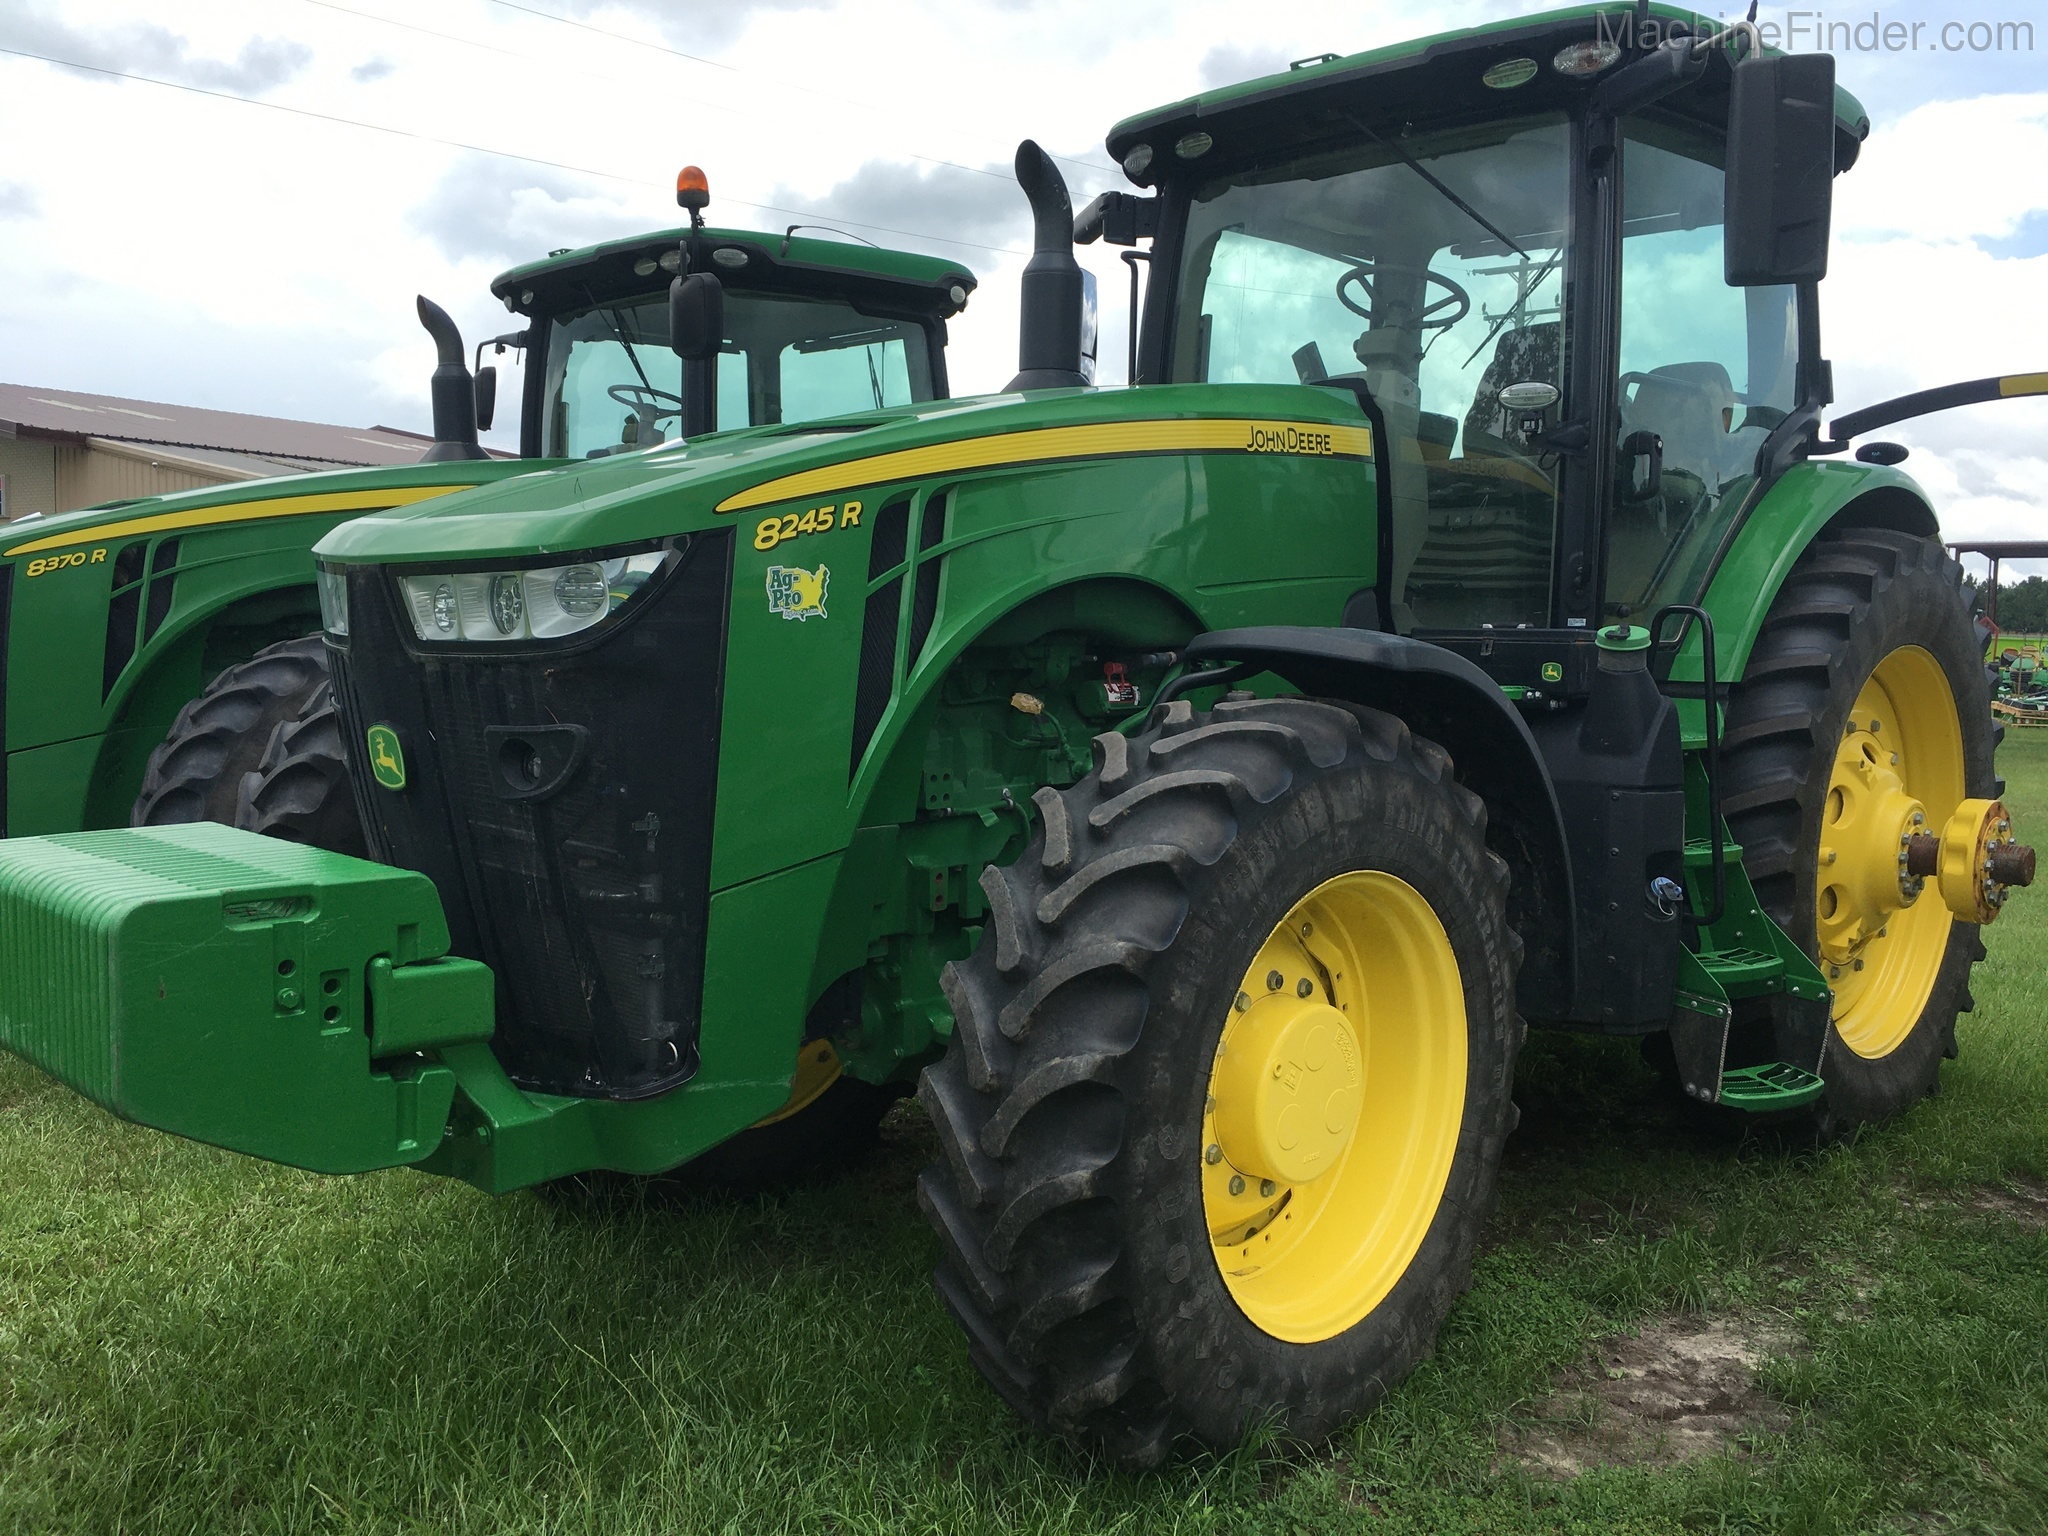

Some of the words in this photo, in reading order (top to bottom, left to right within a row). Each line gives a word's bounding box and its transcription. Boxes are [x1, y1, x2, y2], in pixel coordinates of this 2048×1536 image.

[754, 506, 835, 551] 8245
[840, 501, 863, 530] R
[26, 551, 87, 577] 8370
[90, 548, 107, 564] R
[770, 569, 799, 591] Ag-
[772, 589, 802, 609] Pro
